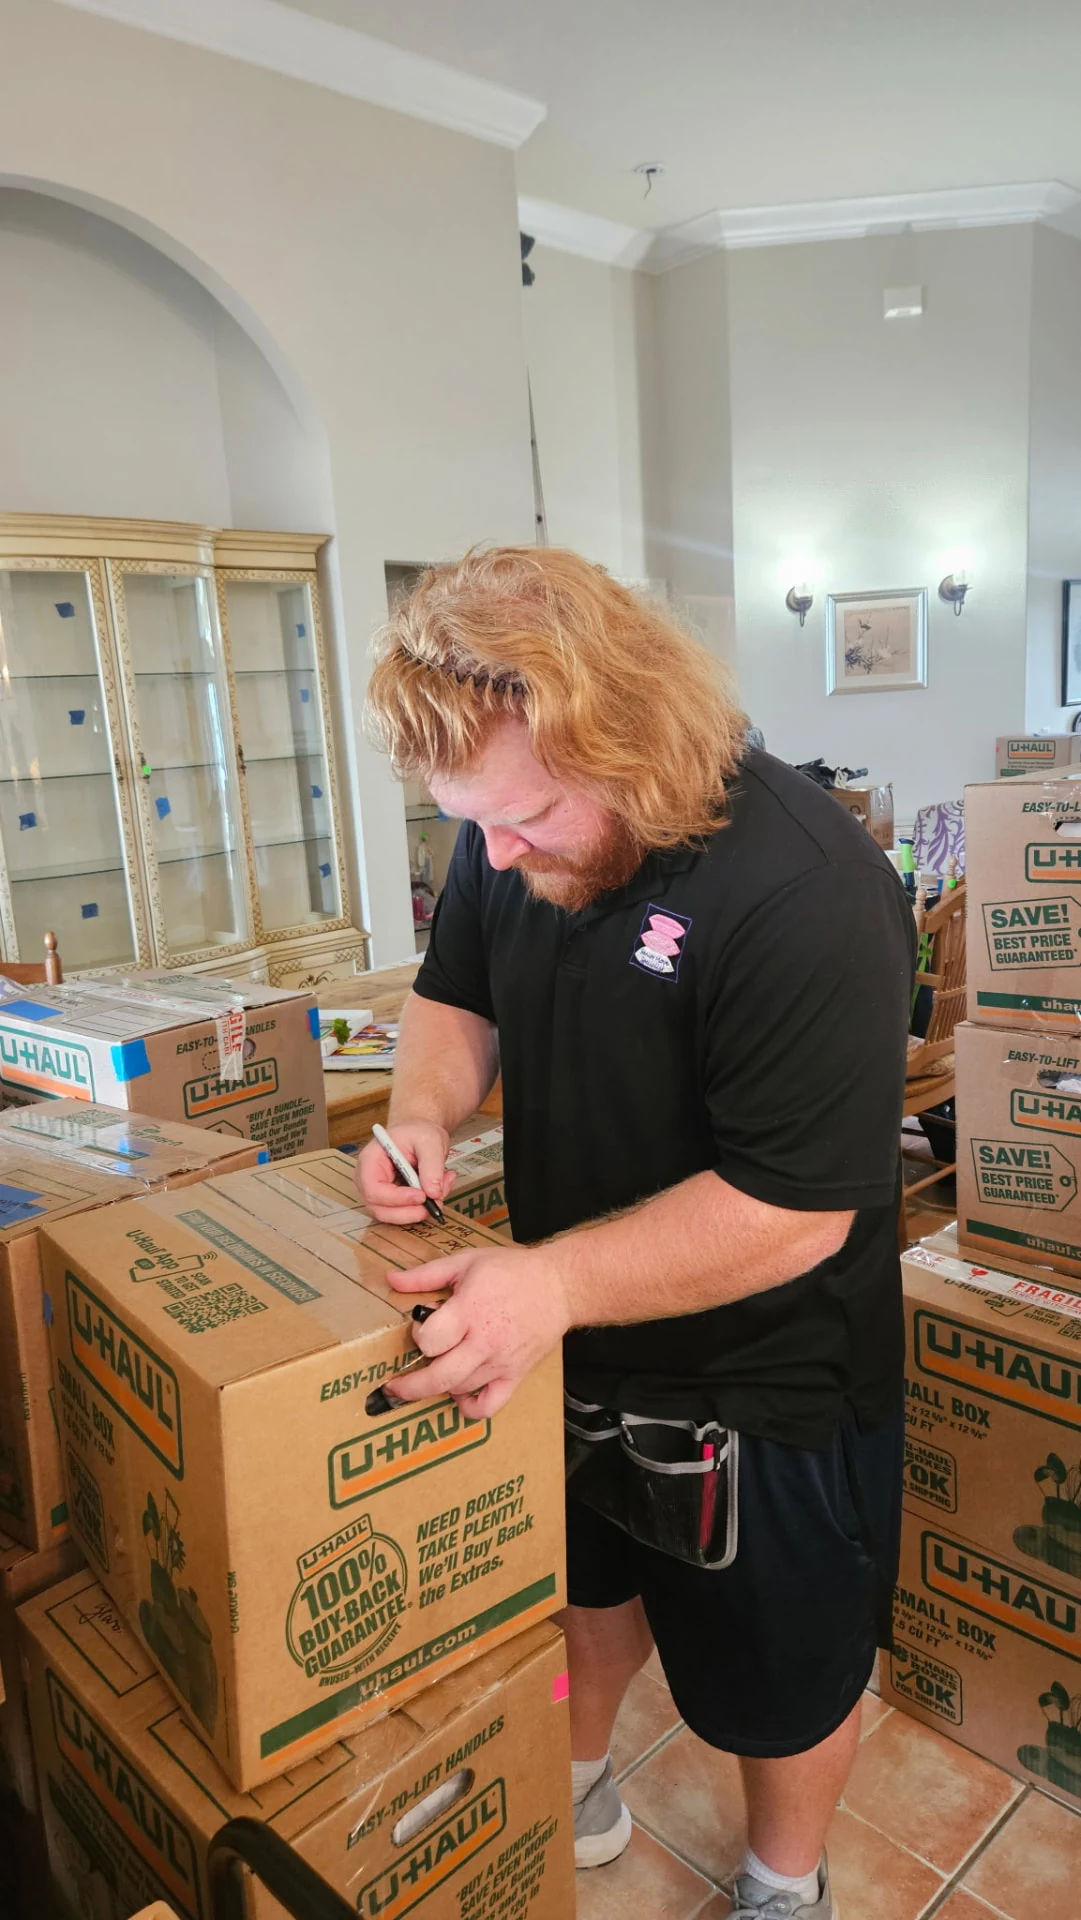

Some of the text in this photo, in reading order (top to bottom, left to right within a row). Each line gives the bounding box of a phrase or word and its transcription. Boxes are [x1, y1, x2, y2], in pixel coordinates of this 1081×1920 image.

[1011, 743, 1053, 752] U-HAUL
[991, 904, 1069, 928] SAVE!
[993, 933, 1071, 951] BEST PRICE
[176, 1020, 277, 1055] EASY-TO- ANDLES
[1008, 1050, 1080, 1069] EASY-TO-LIFT
[0, 1036, 87, 1084] U-HAUL
[190, 1066, 273, 1103] U-HAUL
[250, 1118, 269, 1133] SAVE
[271, 1112, 290, 1126] EVEN
[266, 1108, 272, 1117] A
[979, 1145, 1051, 1169] SAVE!
[982, 1172, 1053, 1191] BEST PRICE
[154, 1253, 180, 1270] App
[72, 1290, 174, 1433] U-HAUL
[927, 1322, 1081, 1404] U-HAU
[92, 1400, 115, 1452] BOX
[904, 1379, 991, 1429] ALL BOX
[920, 1420, 936, 1433] FT
[910, 1464, 951, 1497] OK
[416, 1474, 524, 1544] NEED BOXES?
[418, 1496, 524, 1565] TAKE PLENTY!
[302, 1518, 369, 1571] U-HAUL
[418, 1513, 535, 1588] We'll Buy Back
[300, 1541, 388, 1621] 100%
[418, 1556, 504, 1610] the Extras.
[934, 1543, 1077, 1633] U-HAU
[298, 1569, 402, 1657] BUY-BACK
[957, 1616, 997, 1652] BOX
[909, 1625, 924, 1639] CU
[926, 1634, 941, 1648] FT
[359, 1621, 477, 1698] uhaul.com
[895, 1680, 957, 1720] FOR SHIPPING
[916, 1674, 956, 1709] OK
[56, 1688, 190, 1885] U-HAUL
[346, 1714, 505, 1850] EASY-TO-LIFT HANDLES
[368, 1797, 498, 1916] U-HAUL
[460, 1817, 558, 1918] SAVE EVEN MORE!
[486, 1862, 494, 1879] A
[489, 1883, 508, 1907] Our
[510, 1850, 546, 1888] Bundle
[529, 1883, 540, 1900] in
